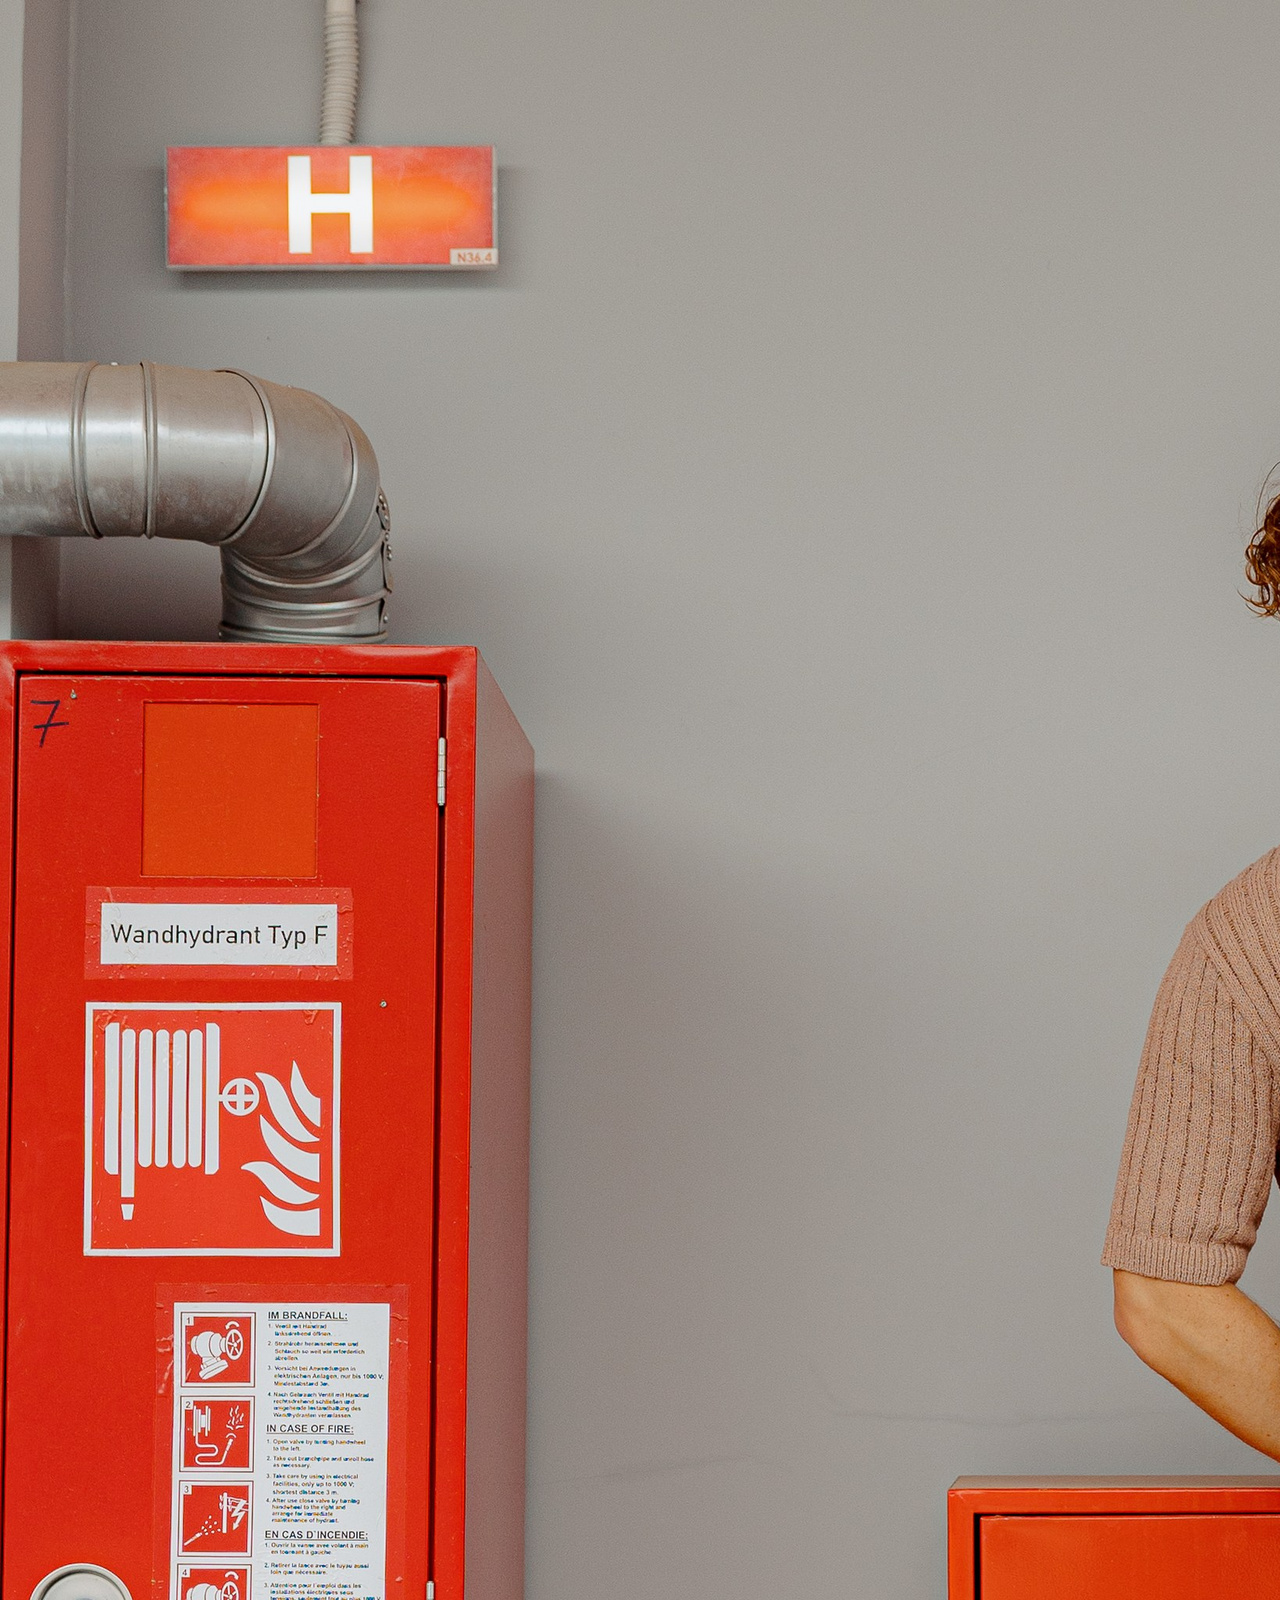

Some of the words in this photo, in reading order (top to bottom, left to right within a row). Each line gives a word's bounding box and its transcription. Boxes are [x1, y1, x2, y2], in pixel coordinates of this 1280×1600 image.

[287, 155, 374, 254] H
[30, 700, 70, 748] 7
[111, 924, 261, 949] Wandhydrant
[268, 925, 307, 949] Typ
[314, 925, 328, 944] F
[268, 1311, 279, 1319] IM
[282, 1311, 348, 1320] BRANDFALL:
[266, 1424, 277, 1432] IN
[280, 1424, 308, 1433] CASE
[311, 1424, 325, 1433] OF
[328, 1424, 354, 1433] FIRE:
[265, 1530, 279, 1538] EN
[282, 1530, 303, 1539] CAS
